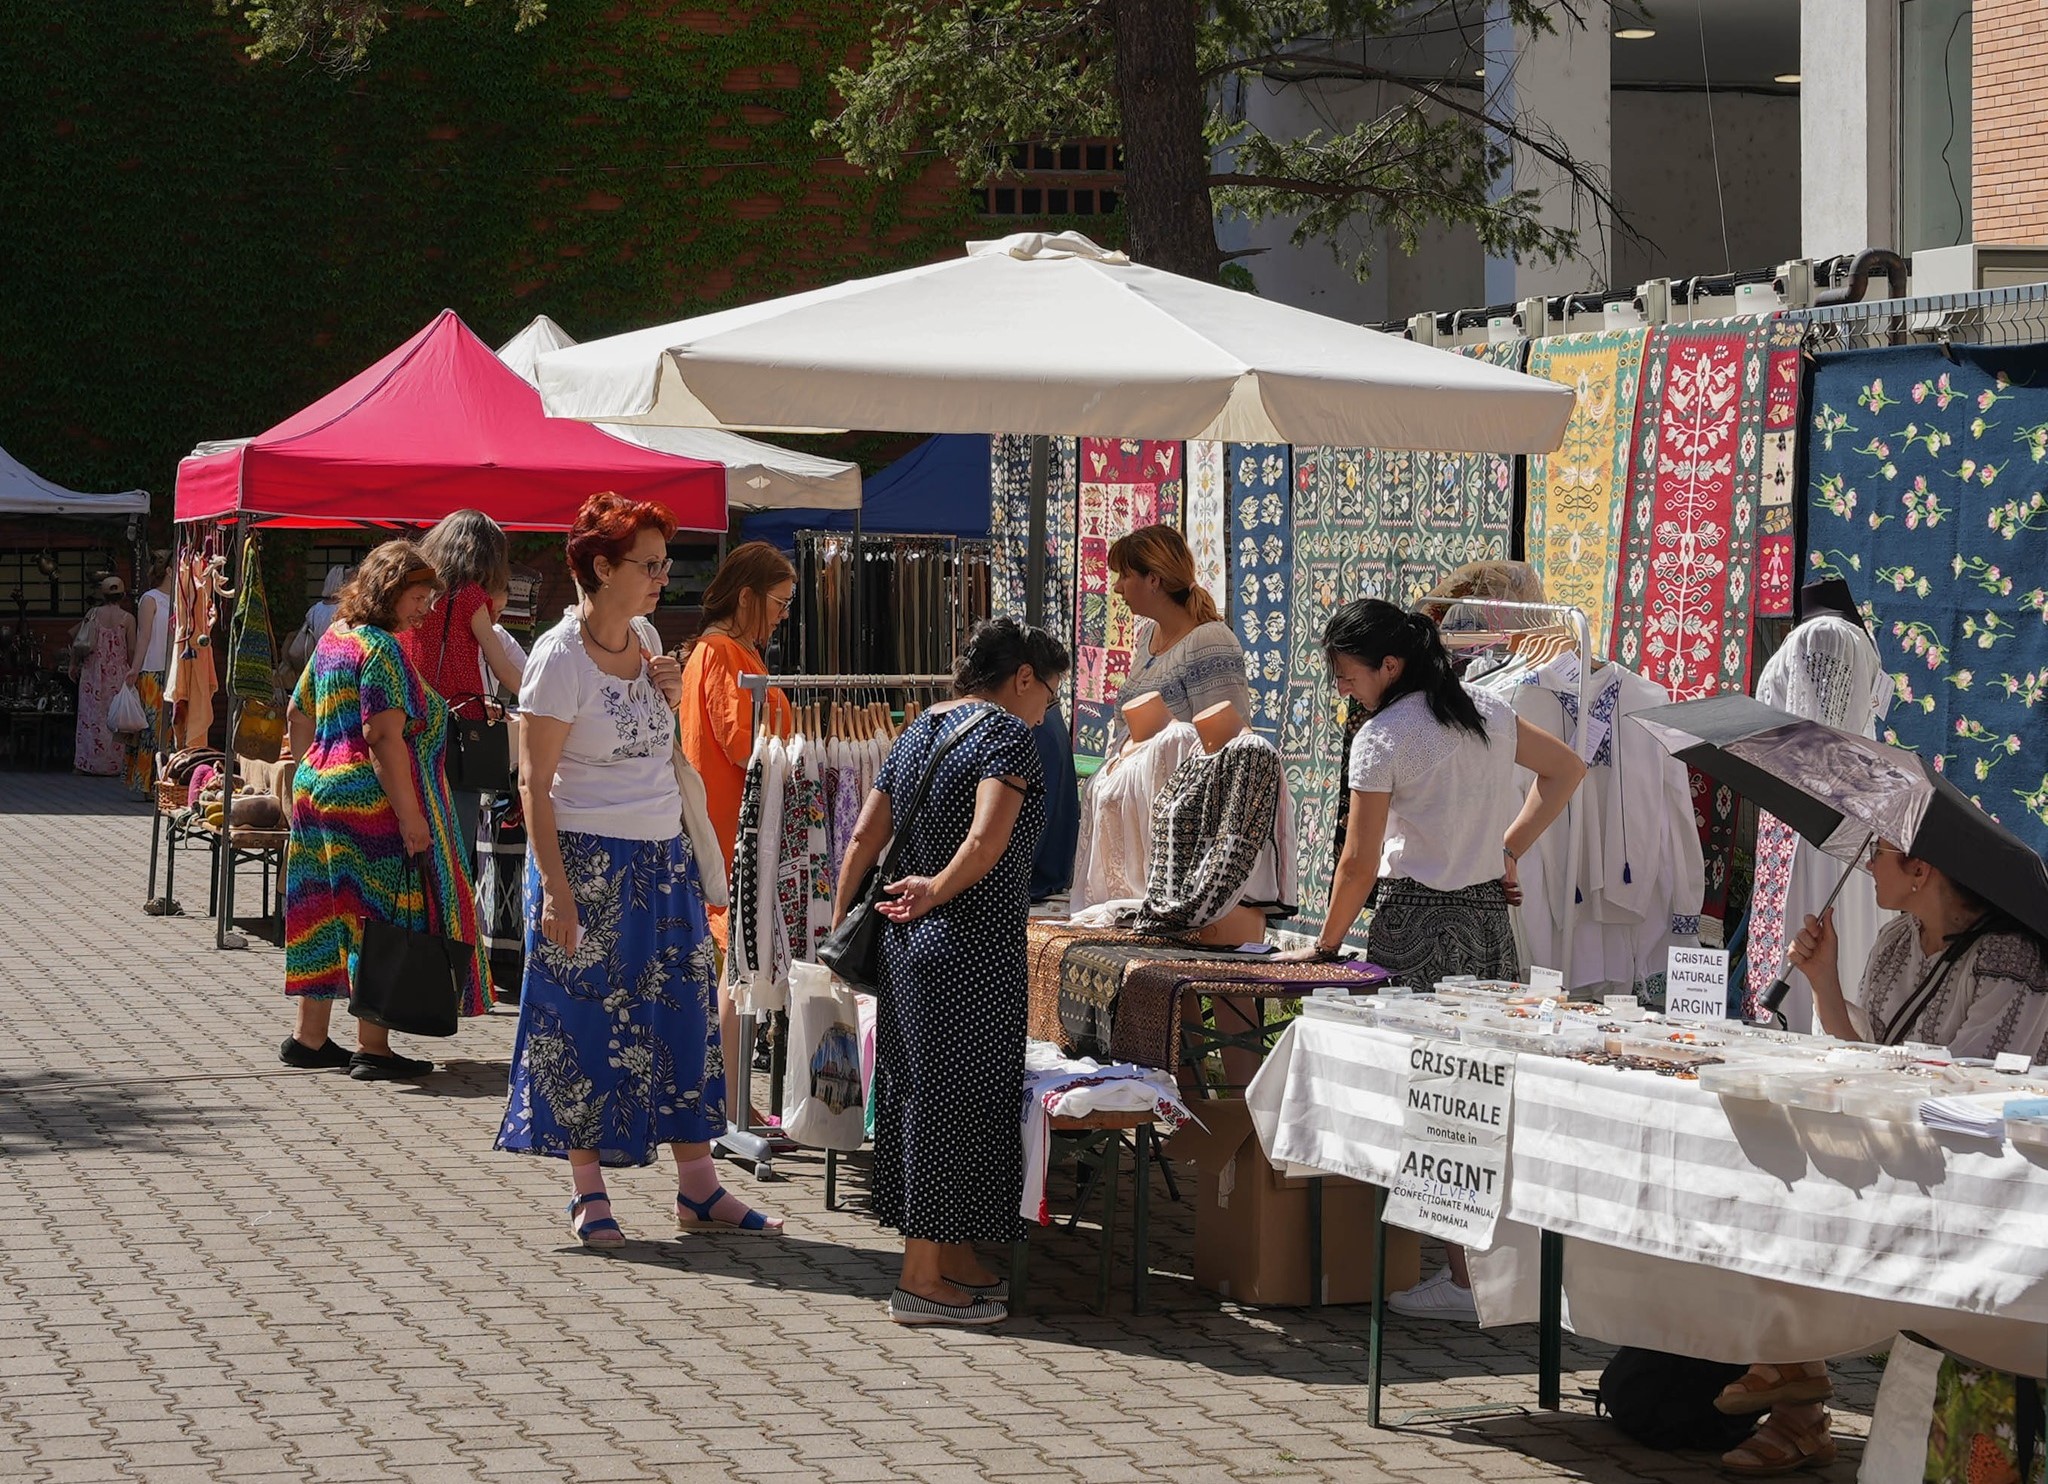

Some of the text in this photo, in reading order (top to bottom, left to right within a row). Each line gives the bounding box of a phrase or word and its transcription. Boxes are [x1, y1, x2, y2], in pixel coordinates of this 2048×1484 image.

[1674, 952, 1723, 967] CRISTALE
[1671, 970, 1724, 985] NATURALE
[1670, 998, 1723, 1016] ARGINT
[1410, 1048, 1505, 1086] CRISTALE
[1408, 1088, 1501, 1126] NATURALE
[1426, 1125, 1477, 1145] montate in
[1401, 1150, 1497, 1195] ARGINT
[1431, 1211, 1469, 1229] ROMÂNIA
[1463, 1203, 1495, 1219] MANUAL
